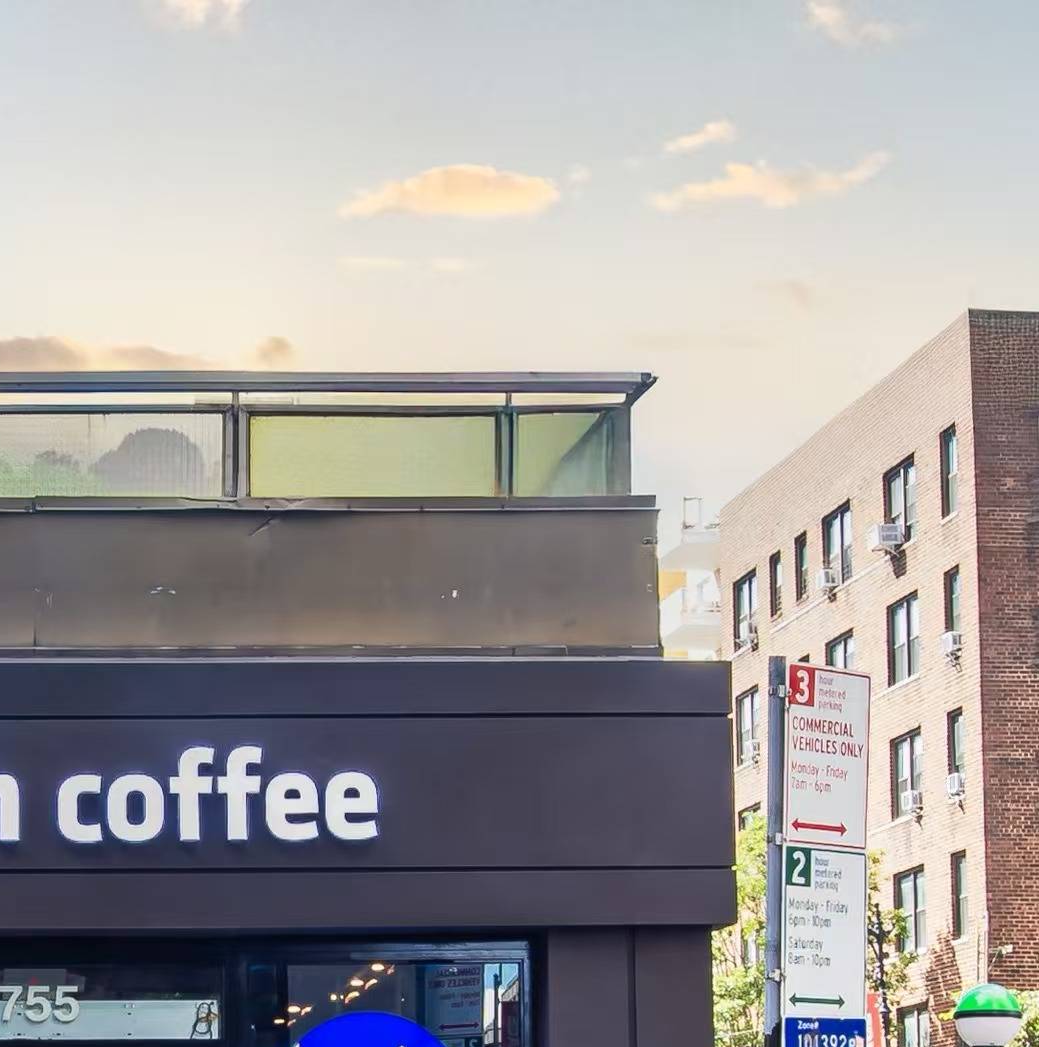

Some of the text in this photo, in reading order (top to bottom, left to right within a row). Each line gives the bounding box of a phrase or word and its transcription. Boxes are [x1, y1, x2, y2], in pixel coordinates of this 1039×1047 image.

[795, 669, 810, 704] 3
[819, 688, 847, 700] metered
[818, 700, 843, 713] parking
[792, 715, 854, 738] COMMERCIAL
[792, 735, 865, 759] VEHICLES ONLY
[791, 761, 819, 777] Monday
[826, 764, 849, 783] Friday
[57, 745, 380, 843] coffee
[814, 781, 832, 794] 6pm
[791, 850, 807, 884] 2
[814, 868, 842, 880] metered
[814, 880, 839, 893] parking
[788, 898, 819, 913] Monday
[826, 900, 848, 916] Friday
[812, 915, 832, 928] 10pm
[788, 936, 824, 953] Saturday
[811, 954, 831, 968] 10pm
